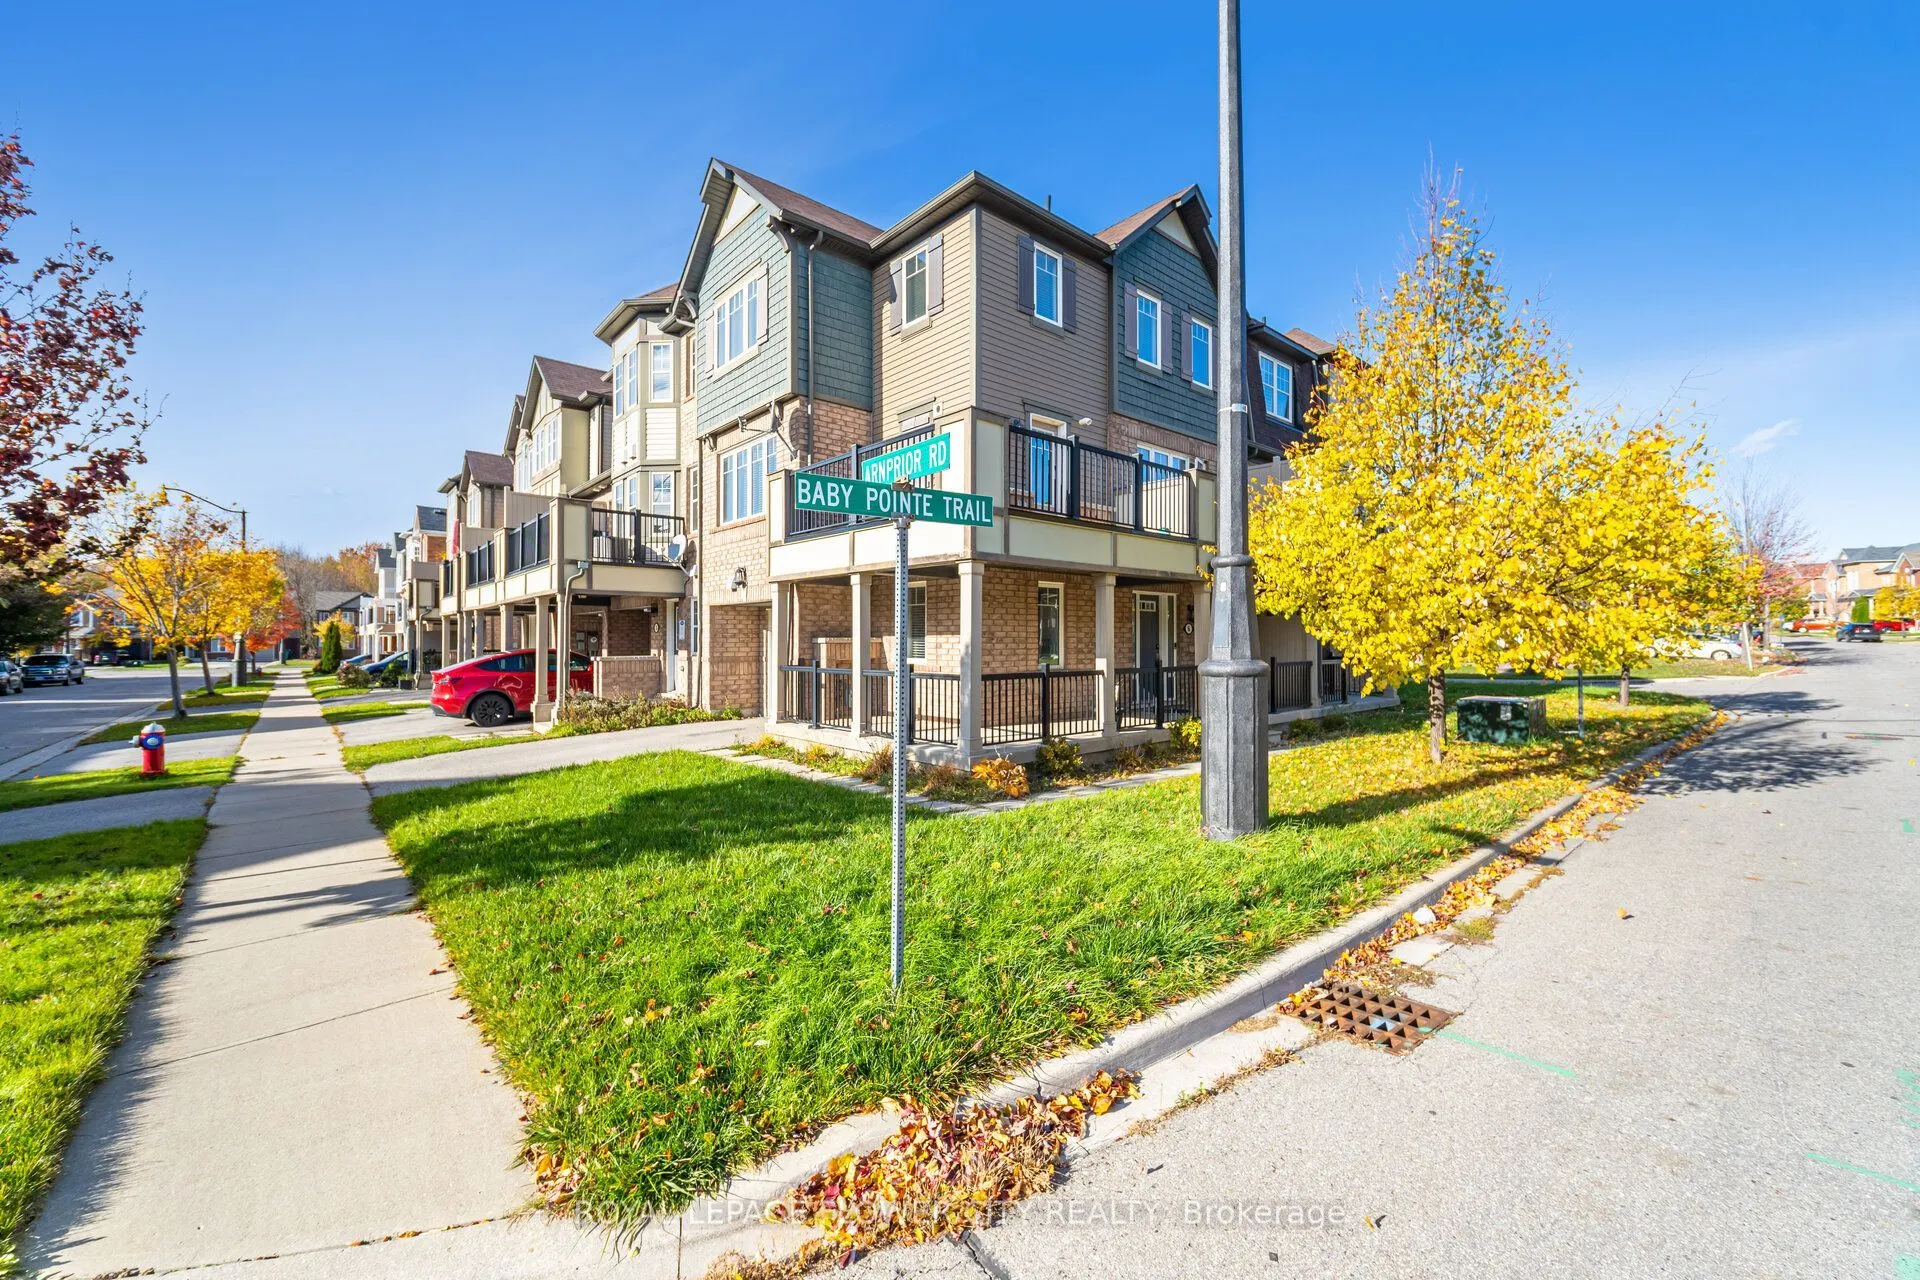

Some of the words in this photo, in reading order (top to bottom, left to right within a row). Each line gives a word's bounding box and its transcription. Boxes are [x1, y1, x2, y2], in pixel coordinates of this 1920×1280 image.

[864, 449, 921, 483] ARNPRIOR
[929, 440, 947, 469] RD
[797, 478, 854, 509] BABY
[866, 487, 933, 517] POINTE
[942, 496, 991, 523] TRAIL
